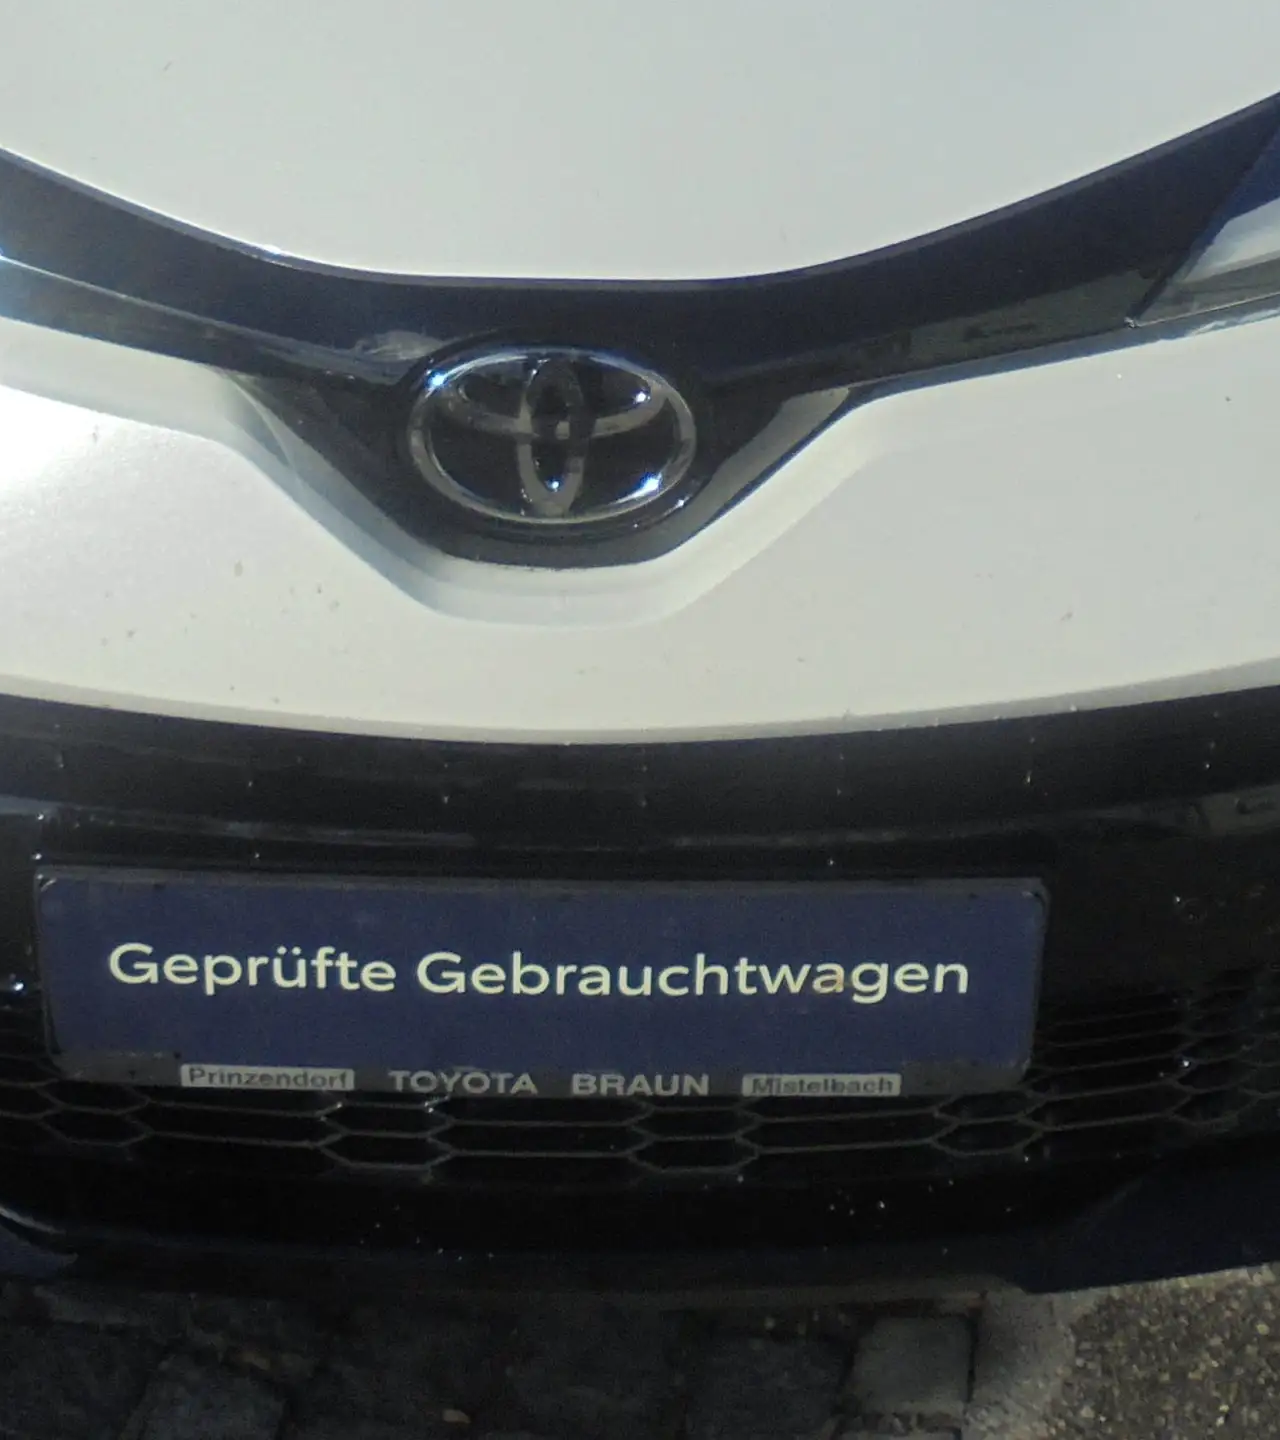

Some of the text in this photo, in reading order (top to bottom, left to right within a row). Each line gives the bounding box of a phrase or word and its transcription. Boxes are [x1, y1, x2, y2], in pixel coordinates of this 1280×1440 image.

[109, 942, 969, 1005] Geprüfte Gebrauchtwagen
[188, 1066, 894, 1097] Prinzendorf TOYOTA BRAUN Mistelbach
